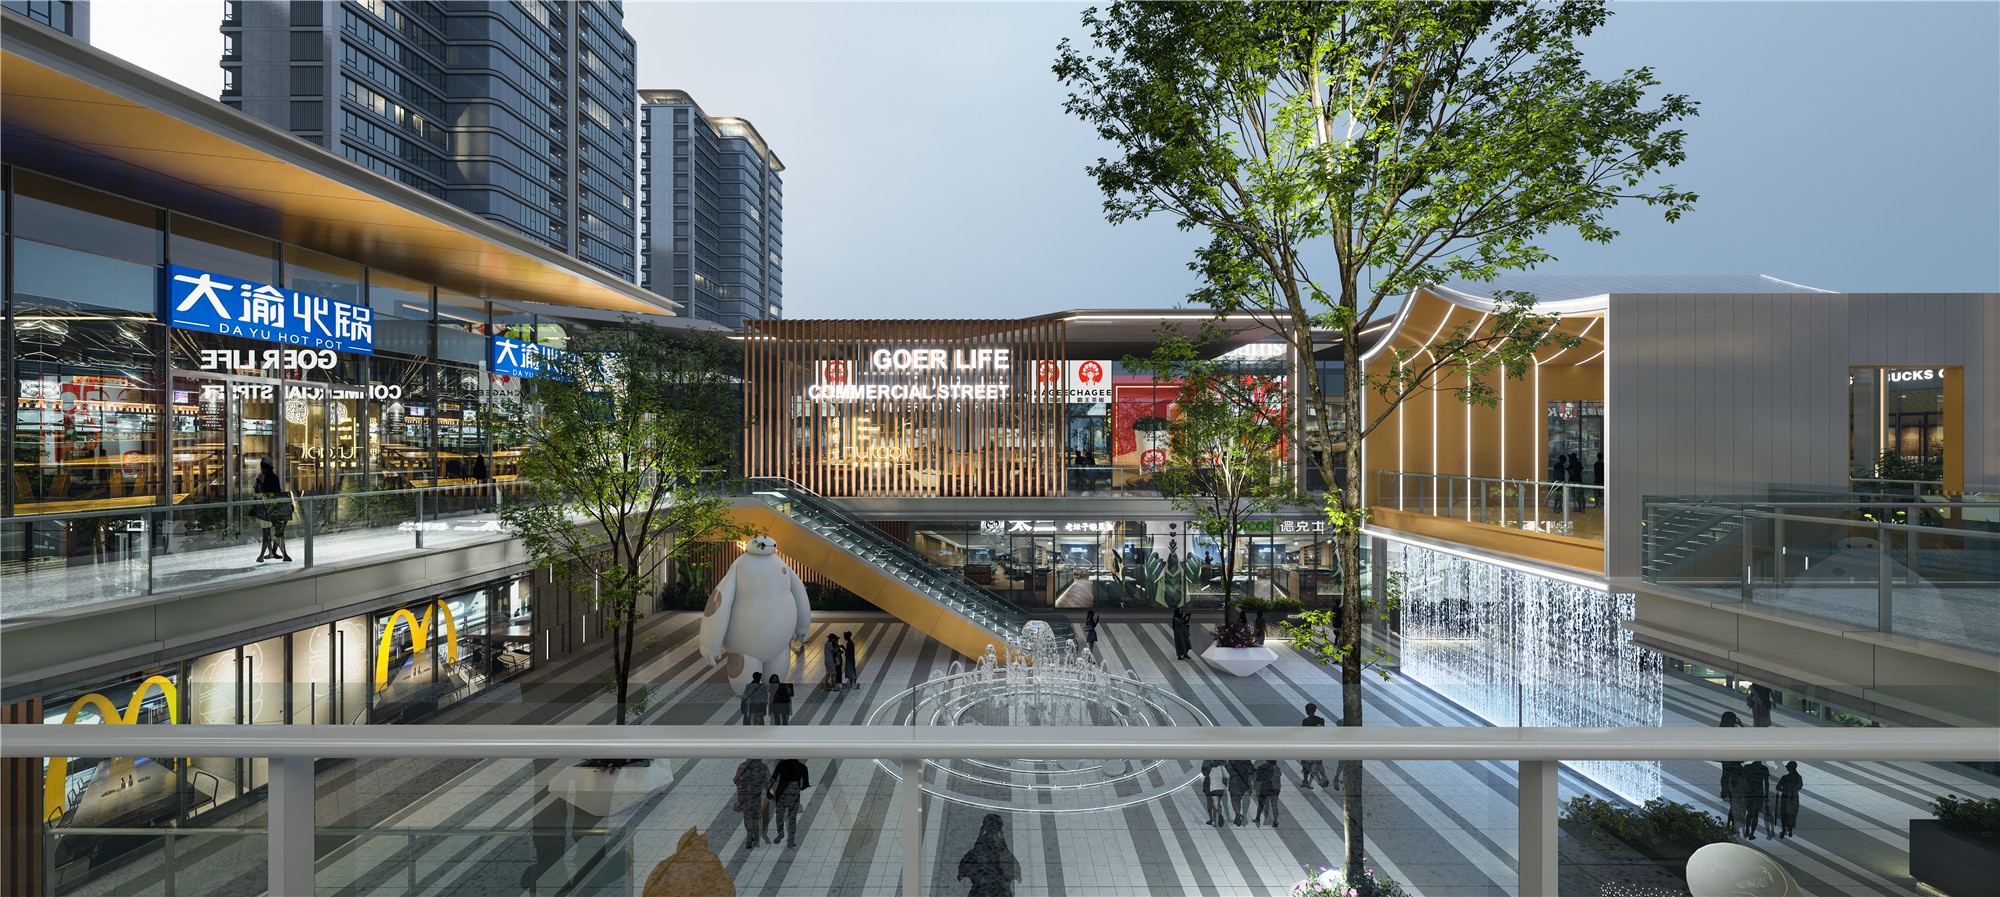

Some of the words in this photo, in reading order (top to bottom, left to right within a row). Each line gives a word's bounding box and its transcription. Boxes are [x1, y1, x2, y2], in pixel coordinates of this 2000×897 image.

[173, 273, 372, 344] 大渝火锅
[219, 322, 243, 336] DA
[249, 326, 271, 340] YU
[278, 332, 309, 345] HOT
[315, 338, 343, 351] POT
[873, 348, 948, 370] GOER
[956, 348, 1010, 370] LIFE
[512, 368, 523, 377] DA
[808, 383, 930, 400] COMMERCIAL
[937, 383, 1010, 400] STREET
